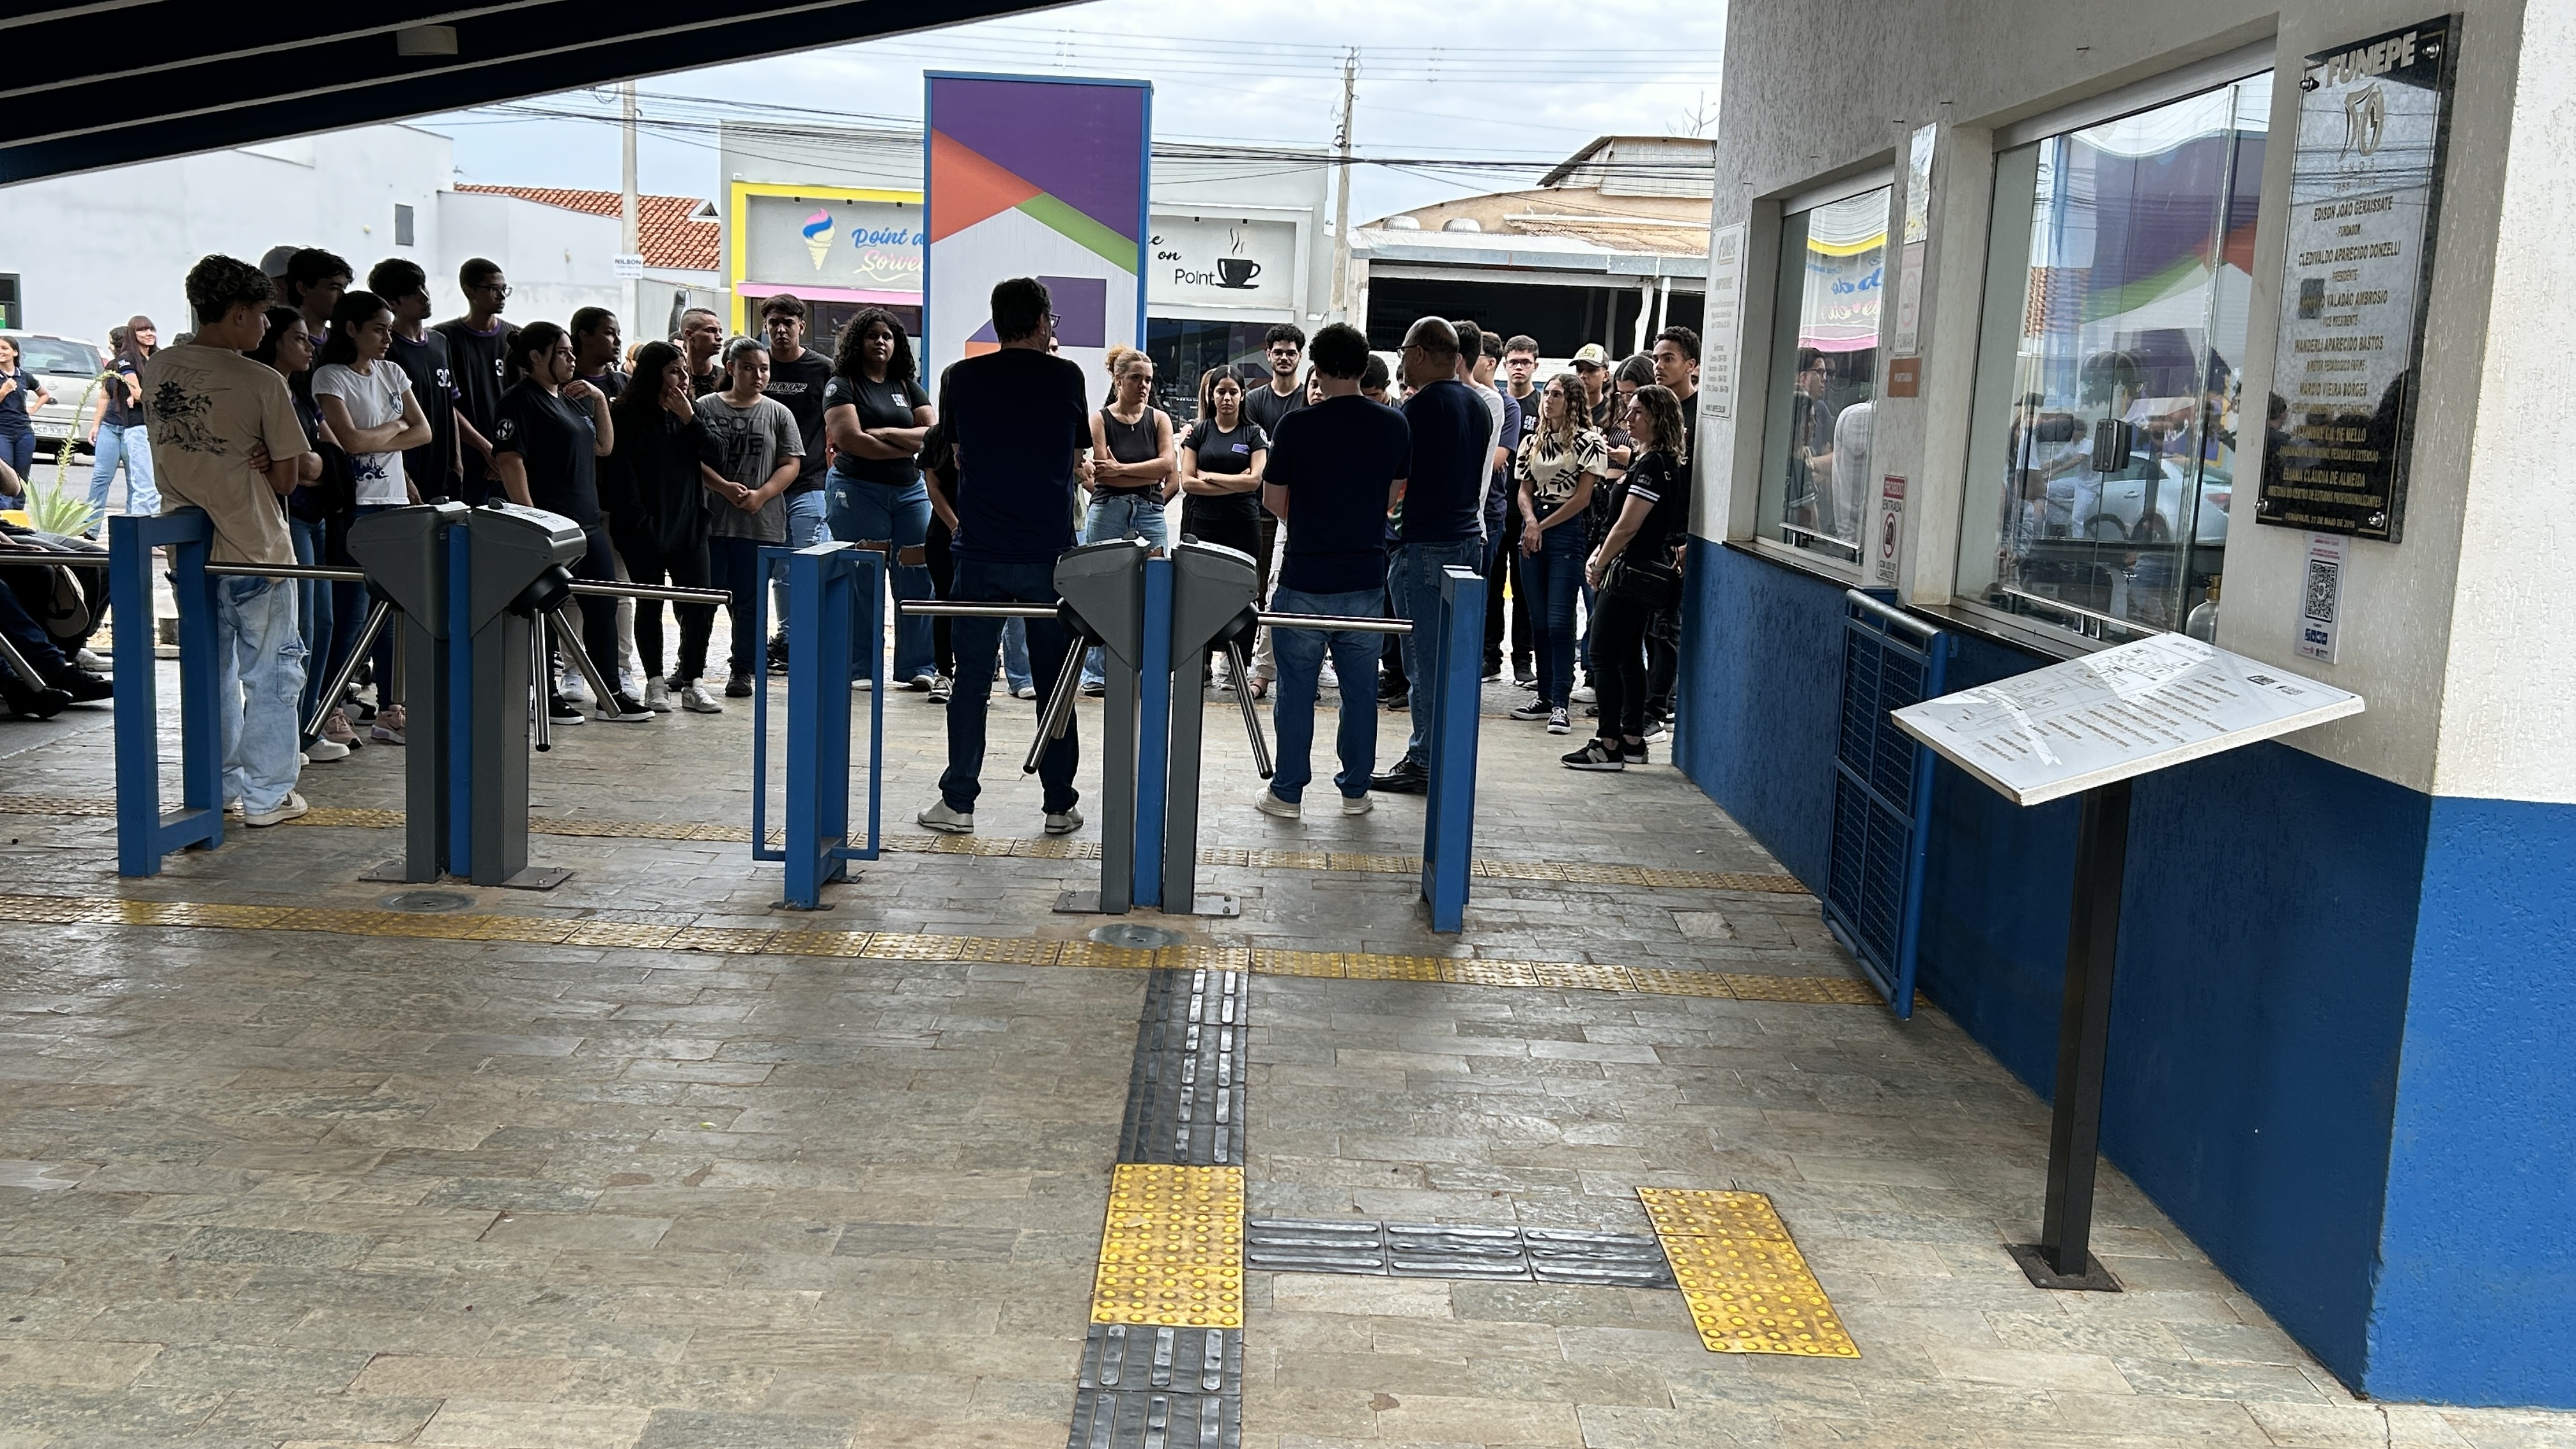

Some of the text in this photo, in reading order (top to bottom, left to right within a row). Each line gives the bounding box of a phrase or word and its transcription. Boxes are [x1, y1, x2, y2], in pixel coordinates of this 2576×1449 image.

[2326, 31, 2417, 88] FUNEPE
[2314, 206, 2336, 222] EDISON
[852, 227, 908, 249] Point
[861, 249, 924, 272] Sorve
[1158, 250, 1181, 261] on
[2299, 240, 2401, 267] CLEDIVALDO APARECIDO DONZELLI
[1175, 268, 1215, 286] Point
[2326, 289, 2354, 308] VALADÃO
[2324, 337, 2358, 351] APARECIDO
[2359, 335, 2384, 351] BASTOS
[150, 362, 212, 391] NIKE
[2322, 382, 2342, 396] VIEIRA
[2343, 383, 2367, 397] BORGES
[2346, 427, 2366, 442] MELLO
[2283, 466, 2365, 487] ELIANA CLÁUDIA DE ALMEIDA
[1885, 481, 1903, 496] PROIBIDO
[1883, 499, 1902, 512] ENTRADA
